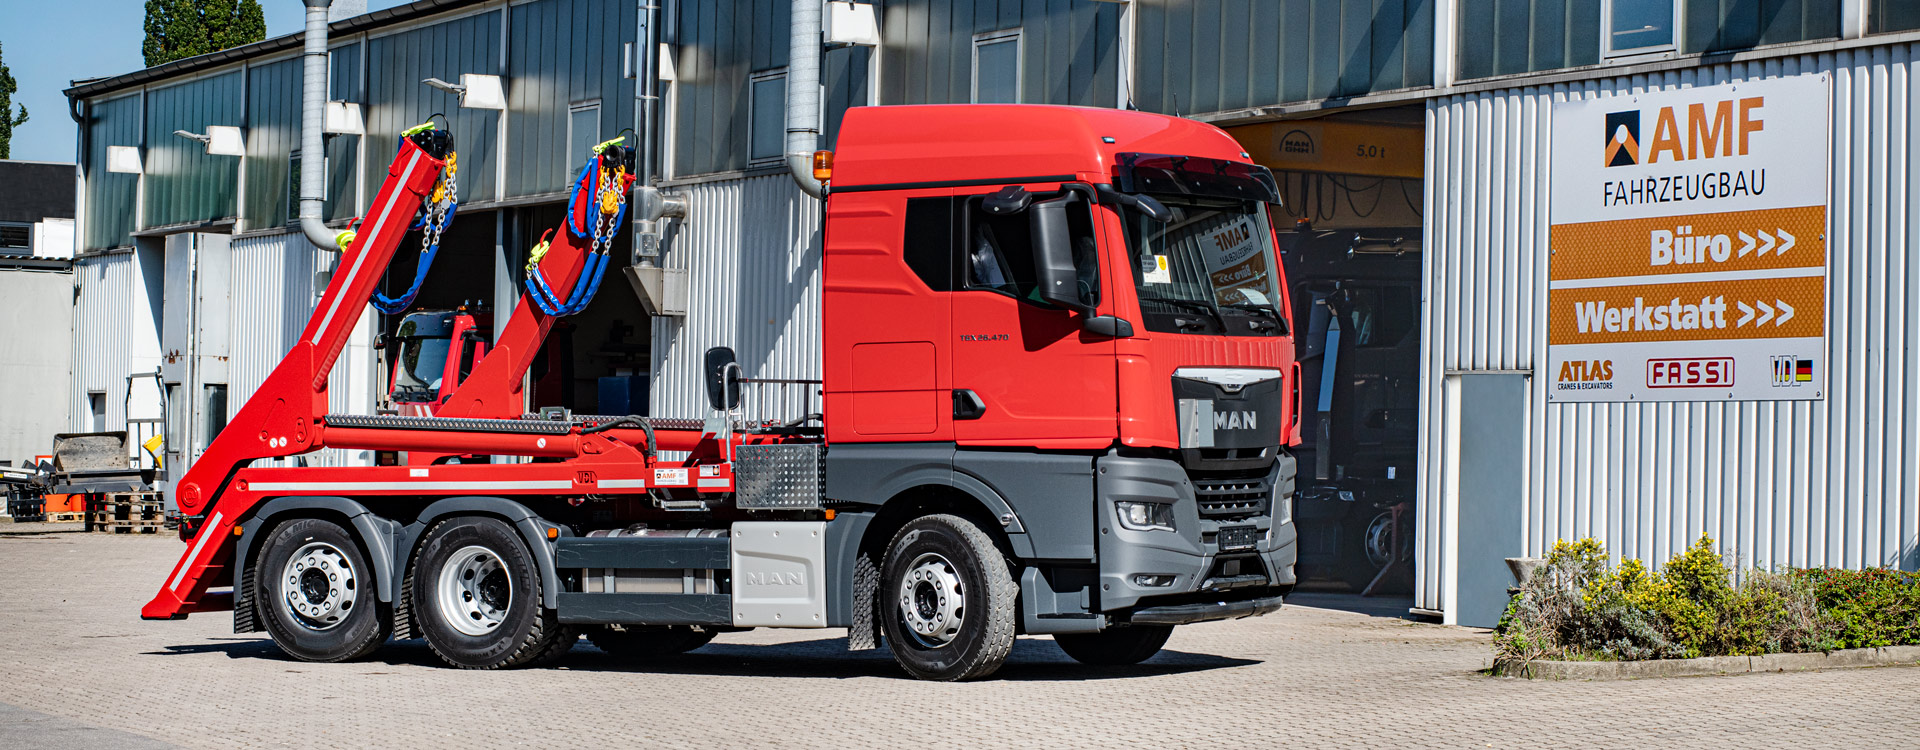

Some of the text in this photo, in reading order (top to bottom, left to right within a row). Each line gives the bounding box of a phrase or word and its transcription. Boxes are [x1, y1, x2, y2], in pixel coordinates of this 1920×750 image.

[1648, 96, 1764, 164] AMF
[1356, 145, 1386, 158] 5,0 t
[1604, 168, 1766, 207] FAHRZEUGBAU
[1650, 225, 1732, 267] Büro
[1574, 294, 1727, 334] Werkstatt
[1558, 359, 1613, 382] ATLAS
[1653, 360, 1728, 385] FASSI
[1769, 354, 1802, 387] VDL
[1582, 382, 1613, 390] EXCAVATORS
[1213, 410, 1257, 430] MAN
[578, 471, 595, 484] VDL
[746, 571, 804, 585] MAN
